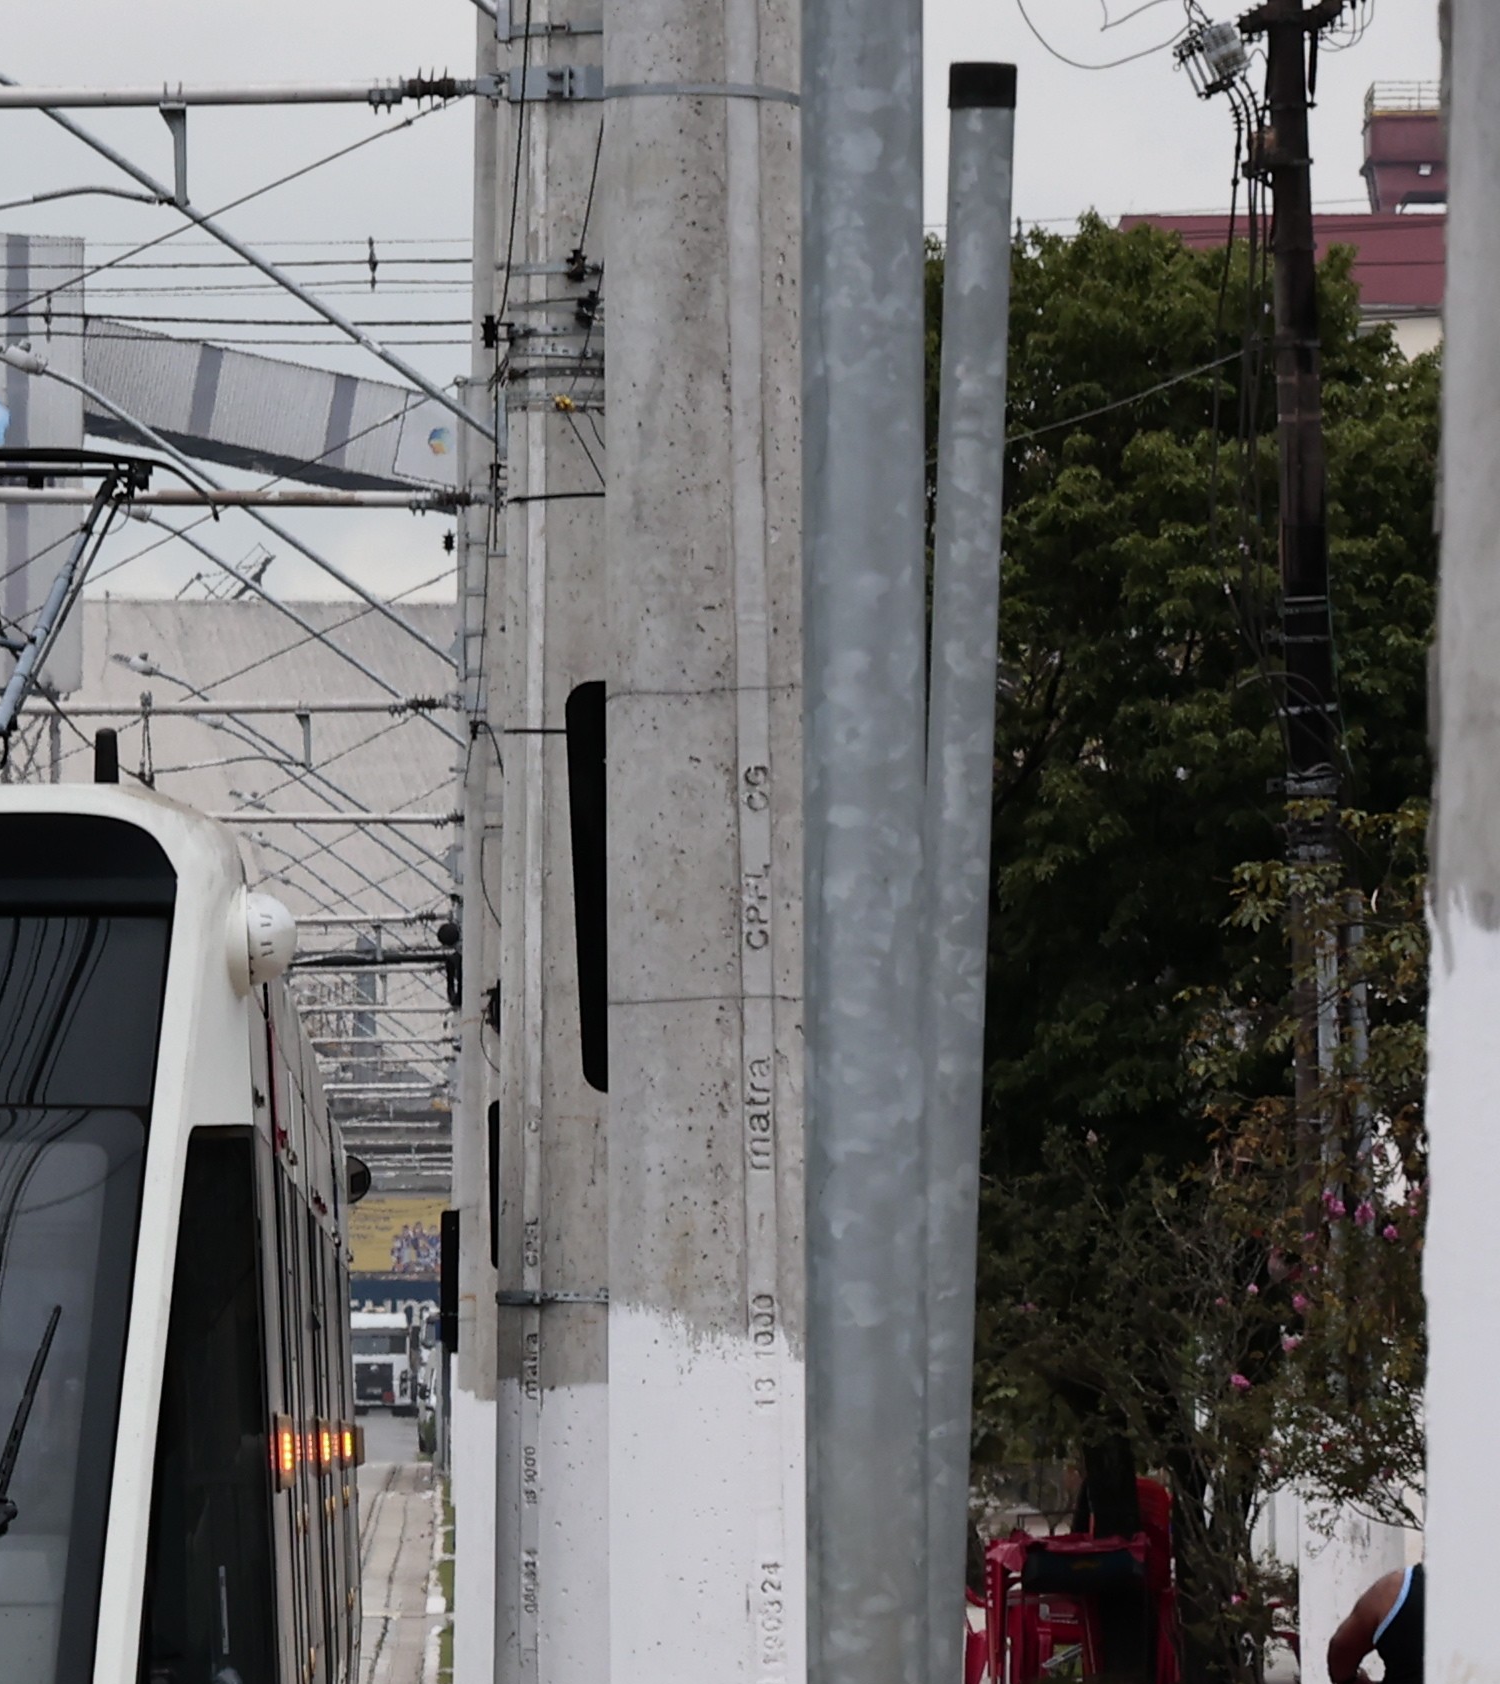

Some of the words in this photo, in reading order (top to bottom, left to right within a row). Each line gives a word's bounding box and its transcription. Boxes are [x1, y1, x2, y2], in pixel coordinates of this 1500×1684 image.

[743, 764, 769, 814] CG
[742, 863, 771, 952] CPFL
[743, 1055, 773, 1172] matra
